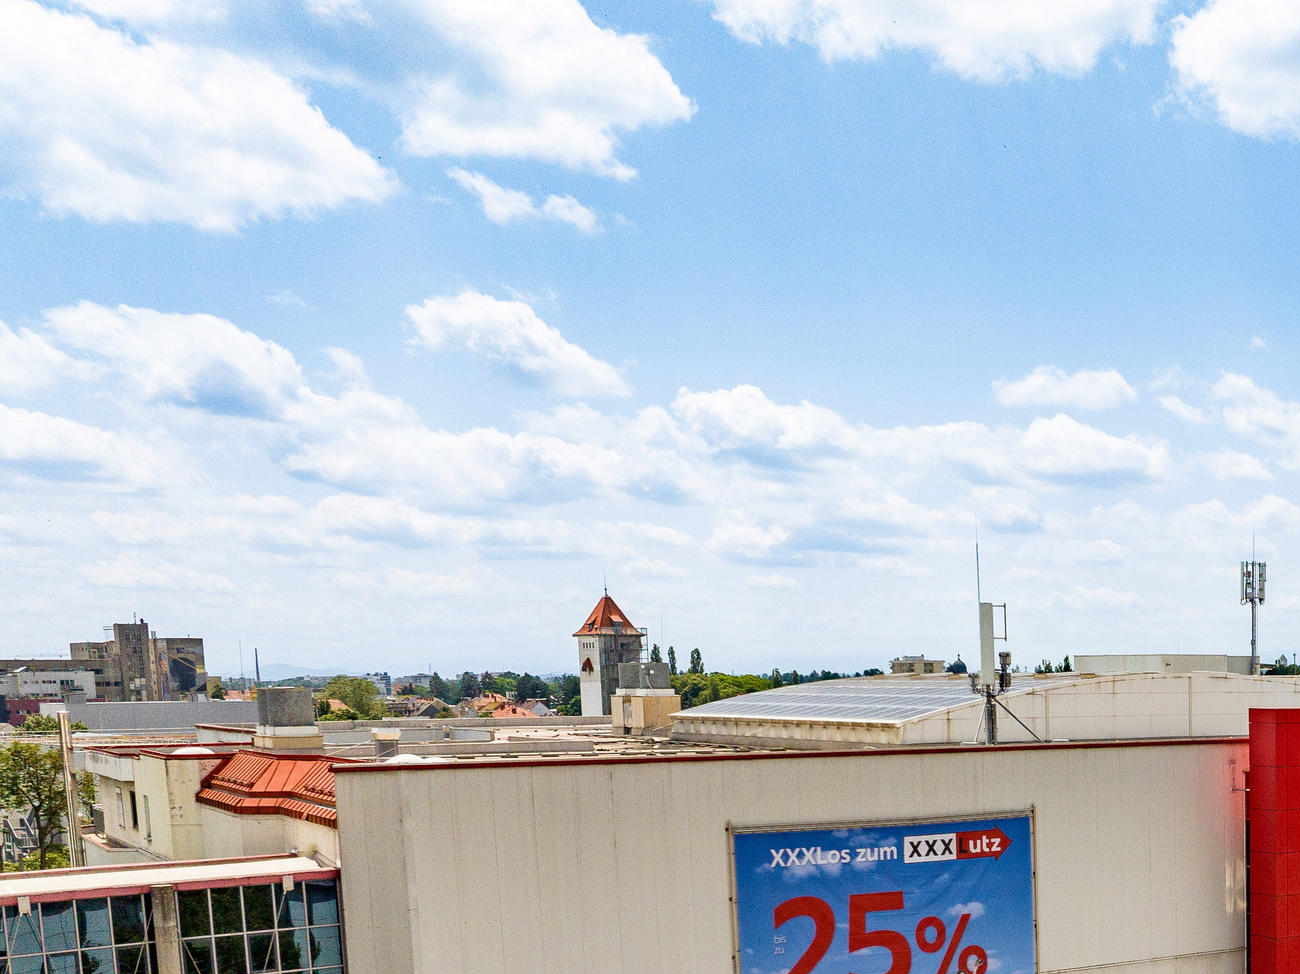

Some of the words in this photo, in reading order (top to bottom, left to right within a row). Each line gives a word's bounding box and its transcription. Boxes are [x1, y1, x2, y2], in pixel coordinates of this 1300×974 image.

[769, 846, 850, 868] XXXLos
[855, 845, 898, 863] zum
[909, 835, 1002, 858] XXXLutz
